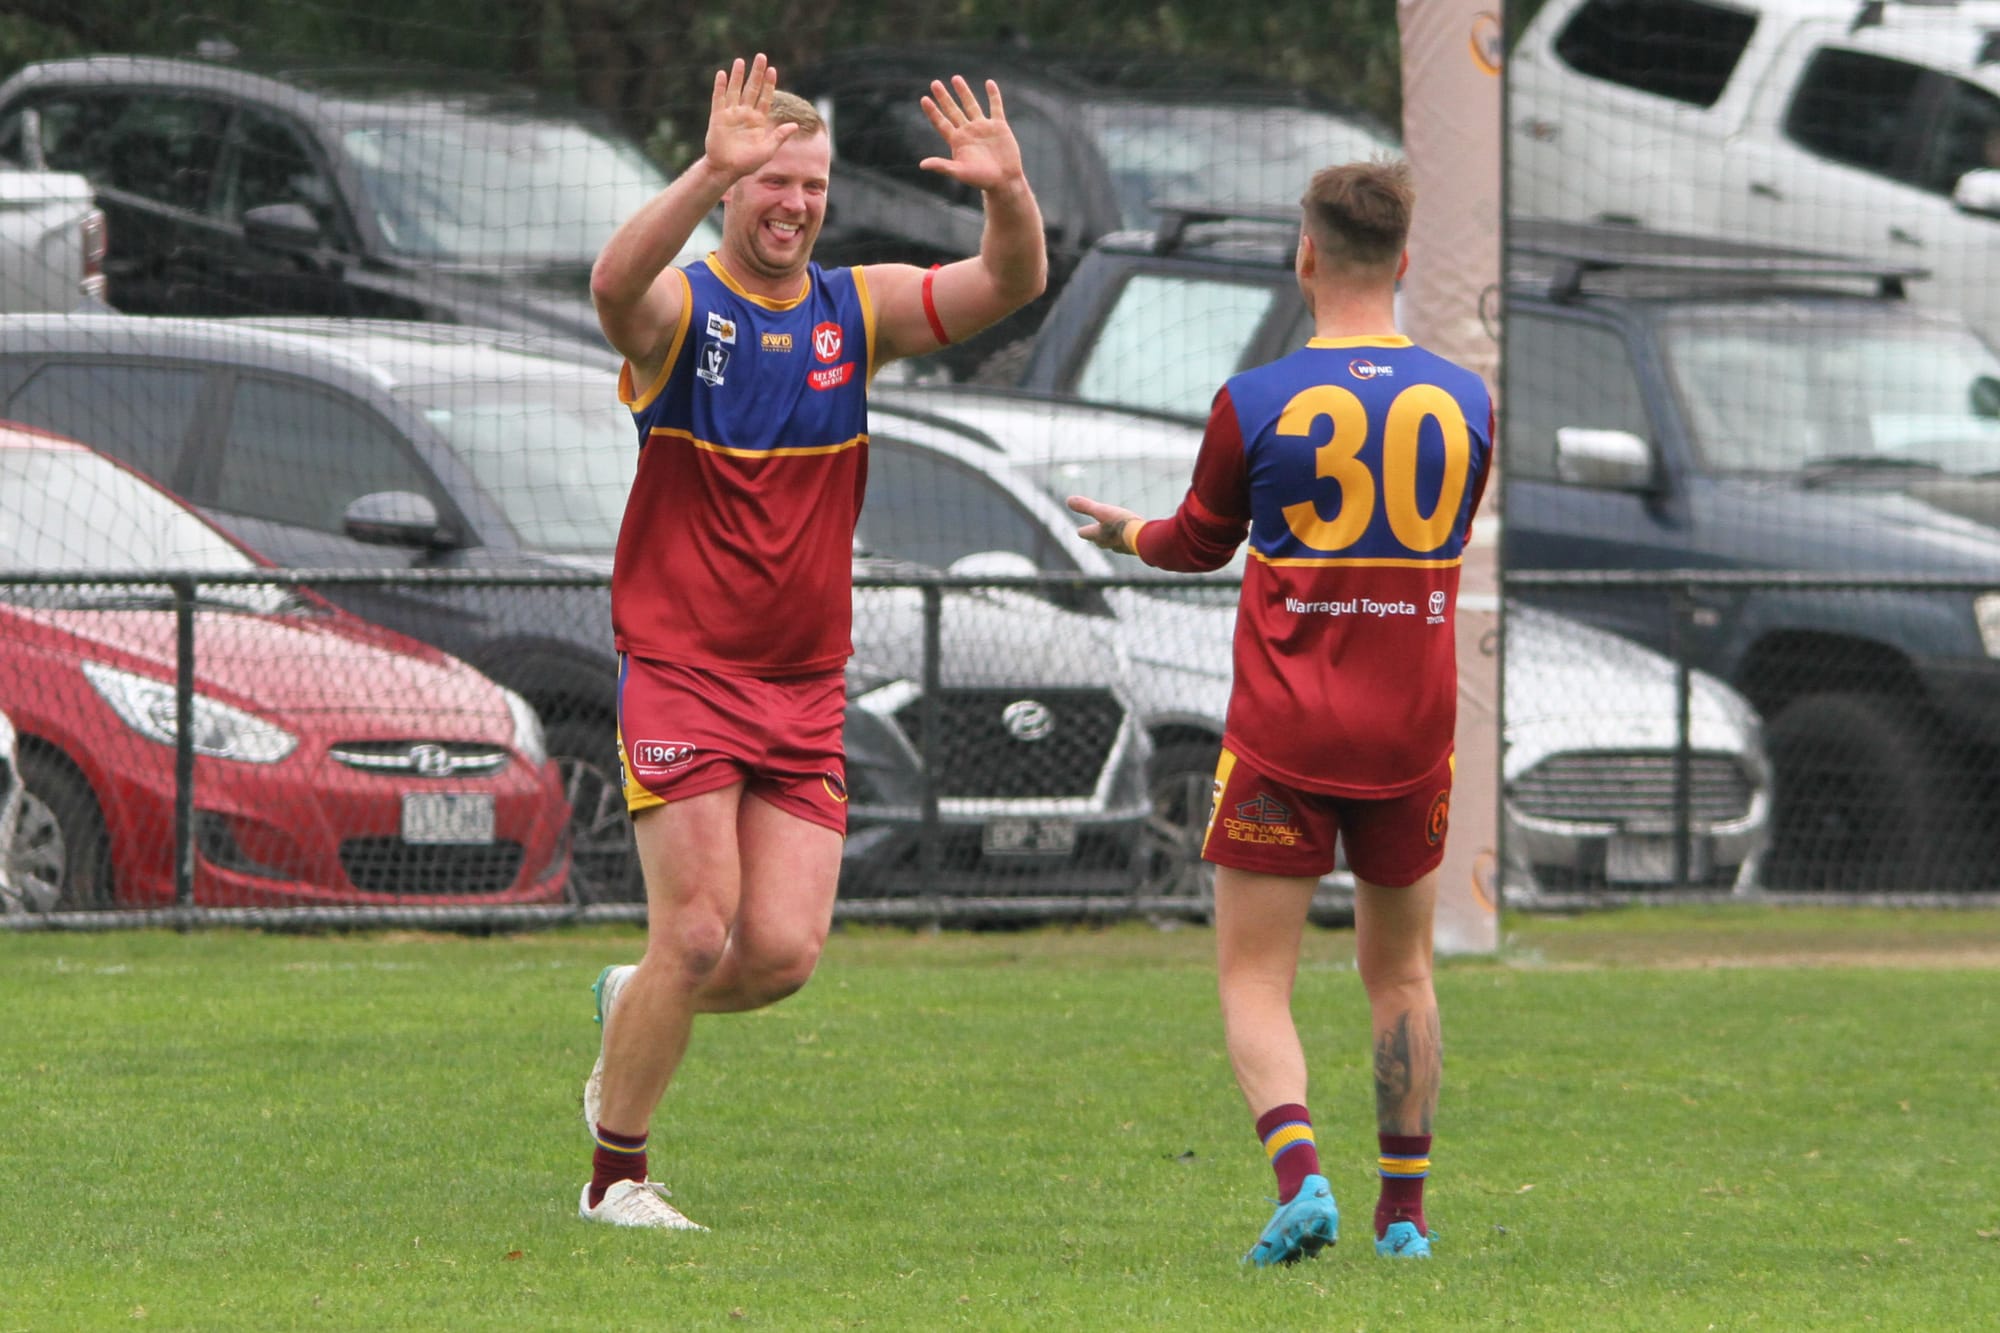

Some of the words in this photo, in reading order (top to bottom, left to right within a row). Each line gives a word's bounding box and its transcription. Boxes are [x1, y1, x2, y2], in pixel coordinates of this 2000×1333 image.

[761, 335, 790, 346] SWD
[1276, 384, 1469, 552] 30
[1285, 597, 1357, 616] Warragul
[1360, 598, 1416, 617] Toyota
[1223, 818, 1303, 836] CORNWALL
[1228, 830, 1295, 845] BUILDING
